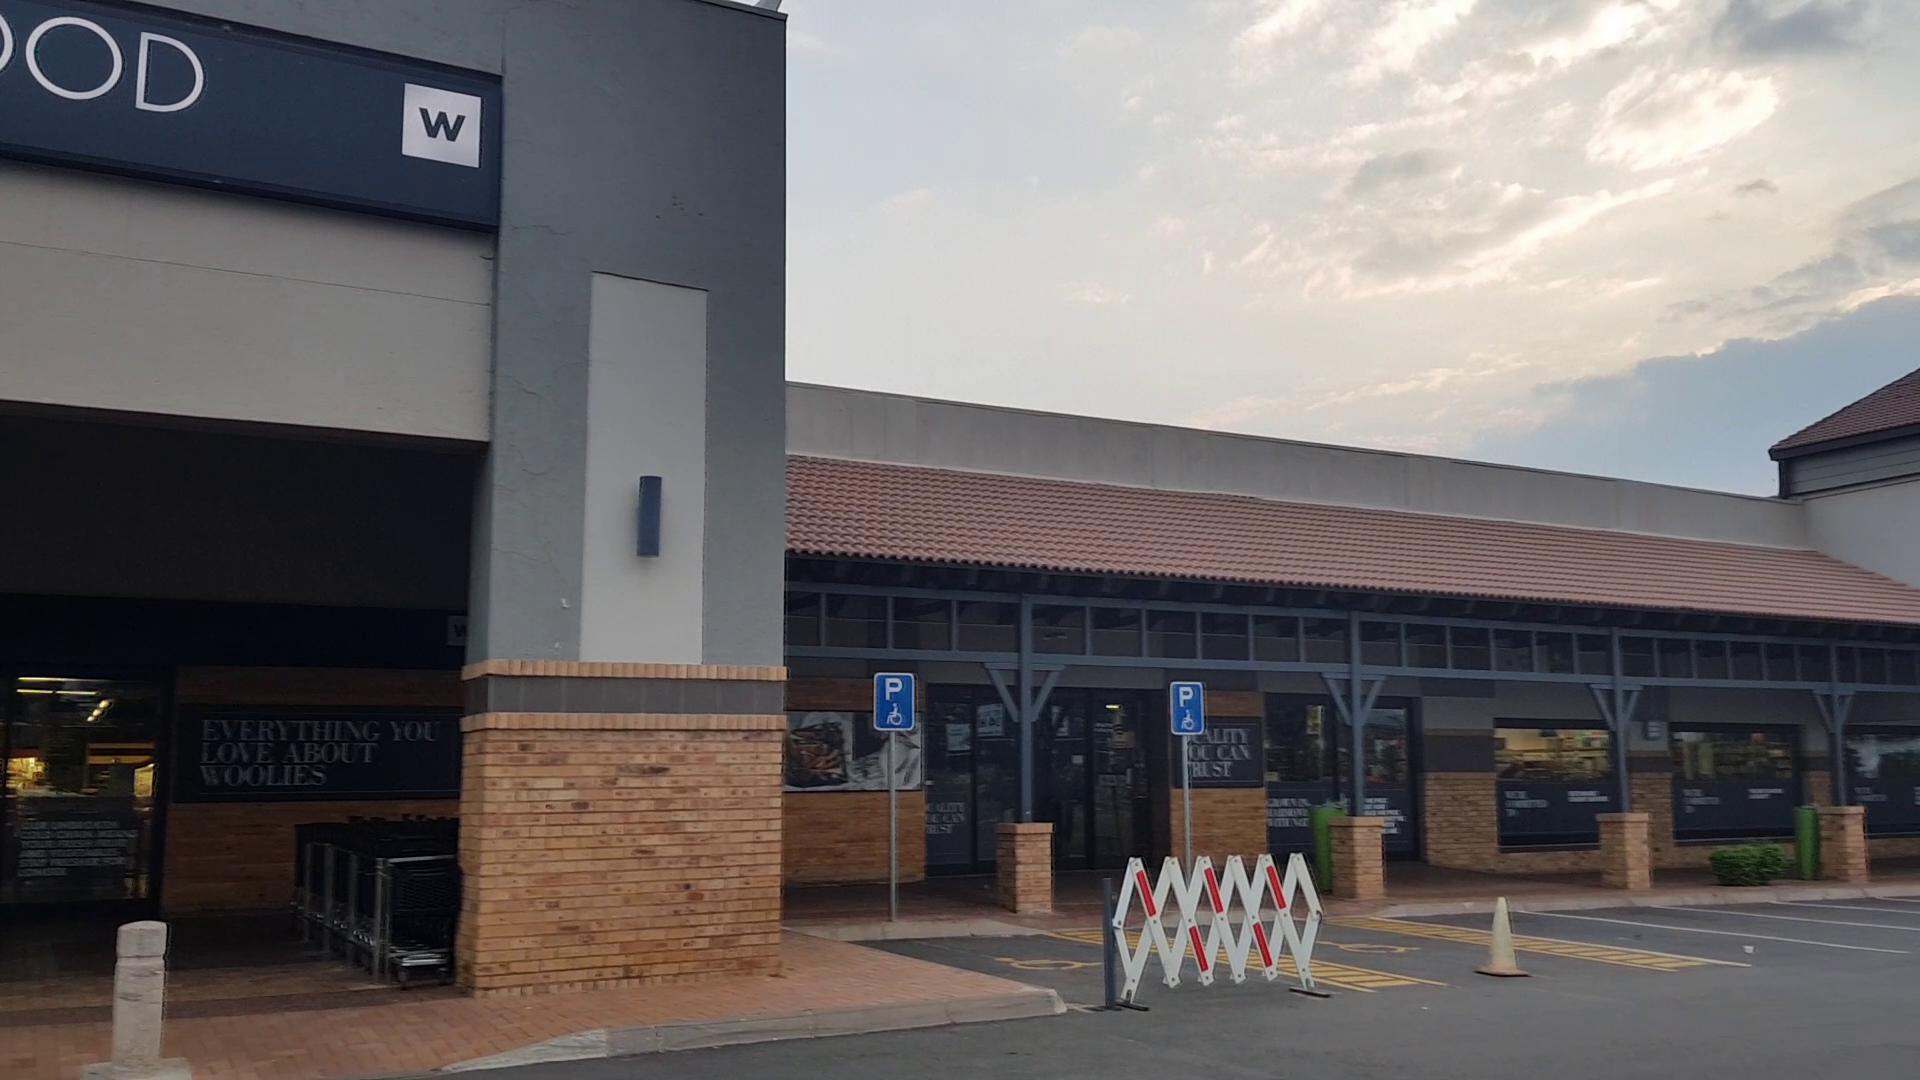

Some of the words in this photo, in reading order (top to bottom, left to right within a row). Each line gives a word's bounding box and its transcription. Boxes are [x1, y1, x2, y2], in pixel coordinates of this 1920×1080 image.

[0, 14, 204, 112] OD
[885, 677, 903, 700] P
[1179, 686, 1193, 707] P
[201, 719, 381, 741] EVERYTHING
[390, 720, 440, 741] YOU
[200, 742, 272, 763] LOVE
[282, 742, 378, 763] ABOUT
[1216, 744, 1252, 760] CAN
[200, 765, 327, 786] WOOLIES
